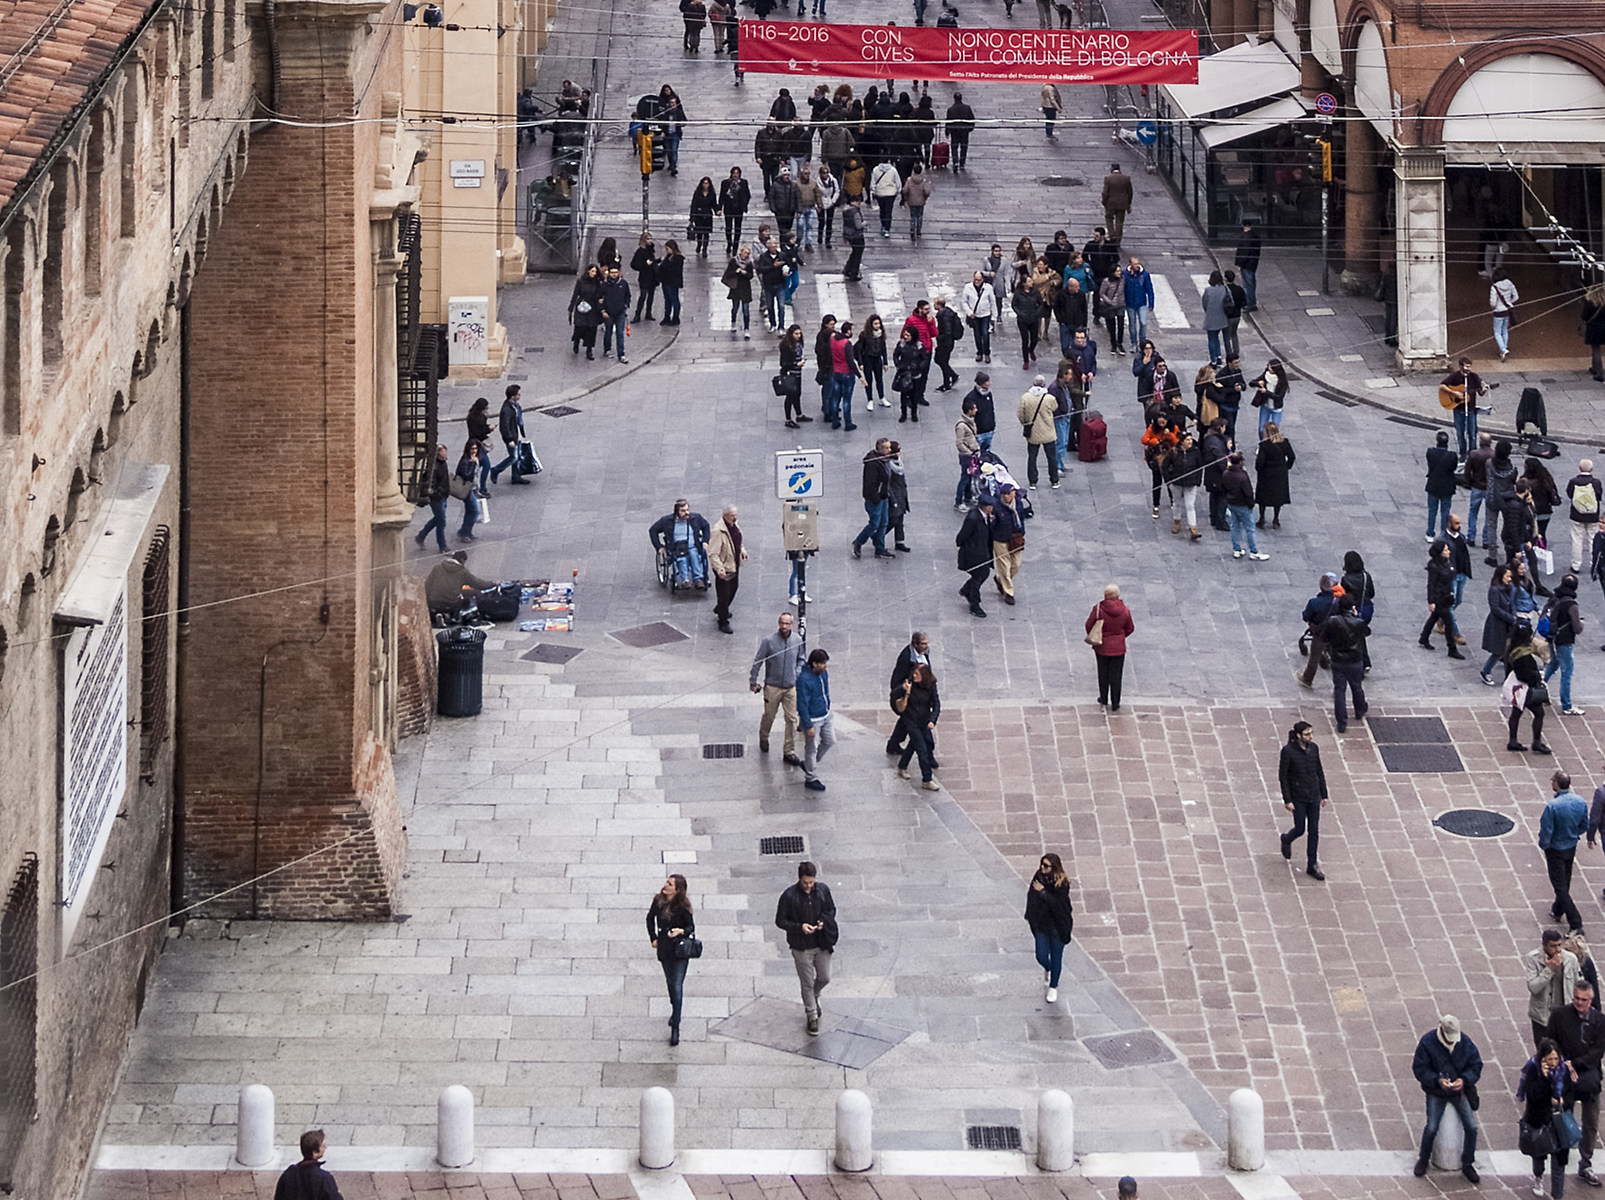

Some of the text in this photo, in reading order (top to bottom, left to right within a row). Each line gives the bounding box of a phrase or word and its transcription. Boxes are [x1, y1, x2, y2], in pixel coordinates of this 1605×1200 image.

[861, 29, 901, 45] CON
[948, 32, 1129, 50] NONO CENTENARIO
[861, 45, 914, 62] CIVES
[948, 49, 1192, 67] DEL COMUNE DI BOLOGNA
